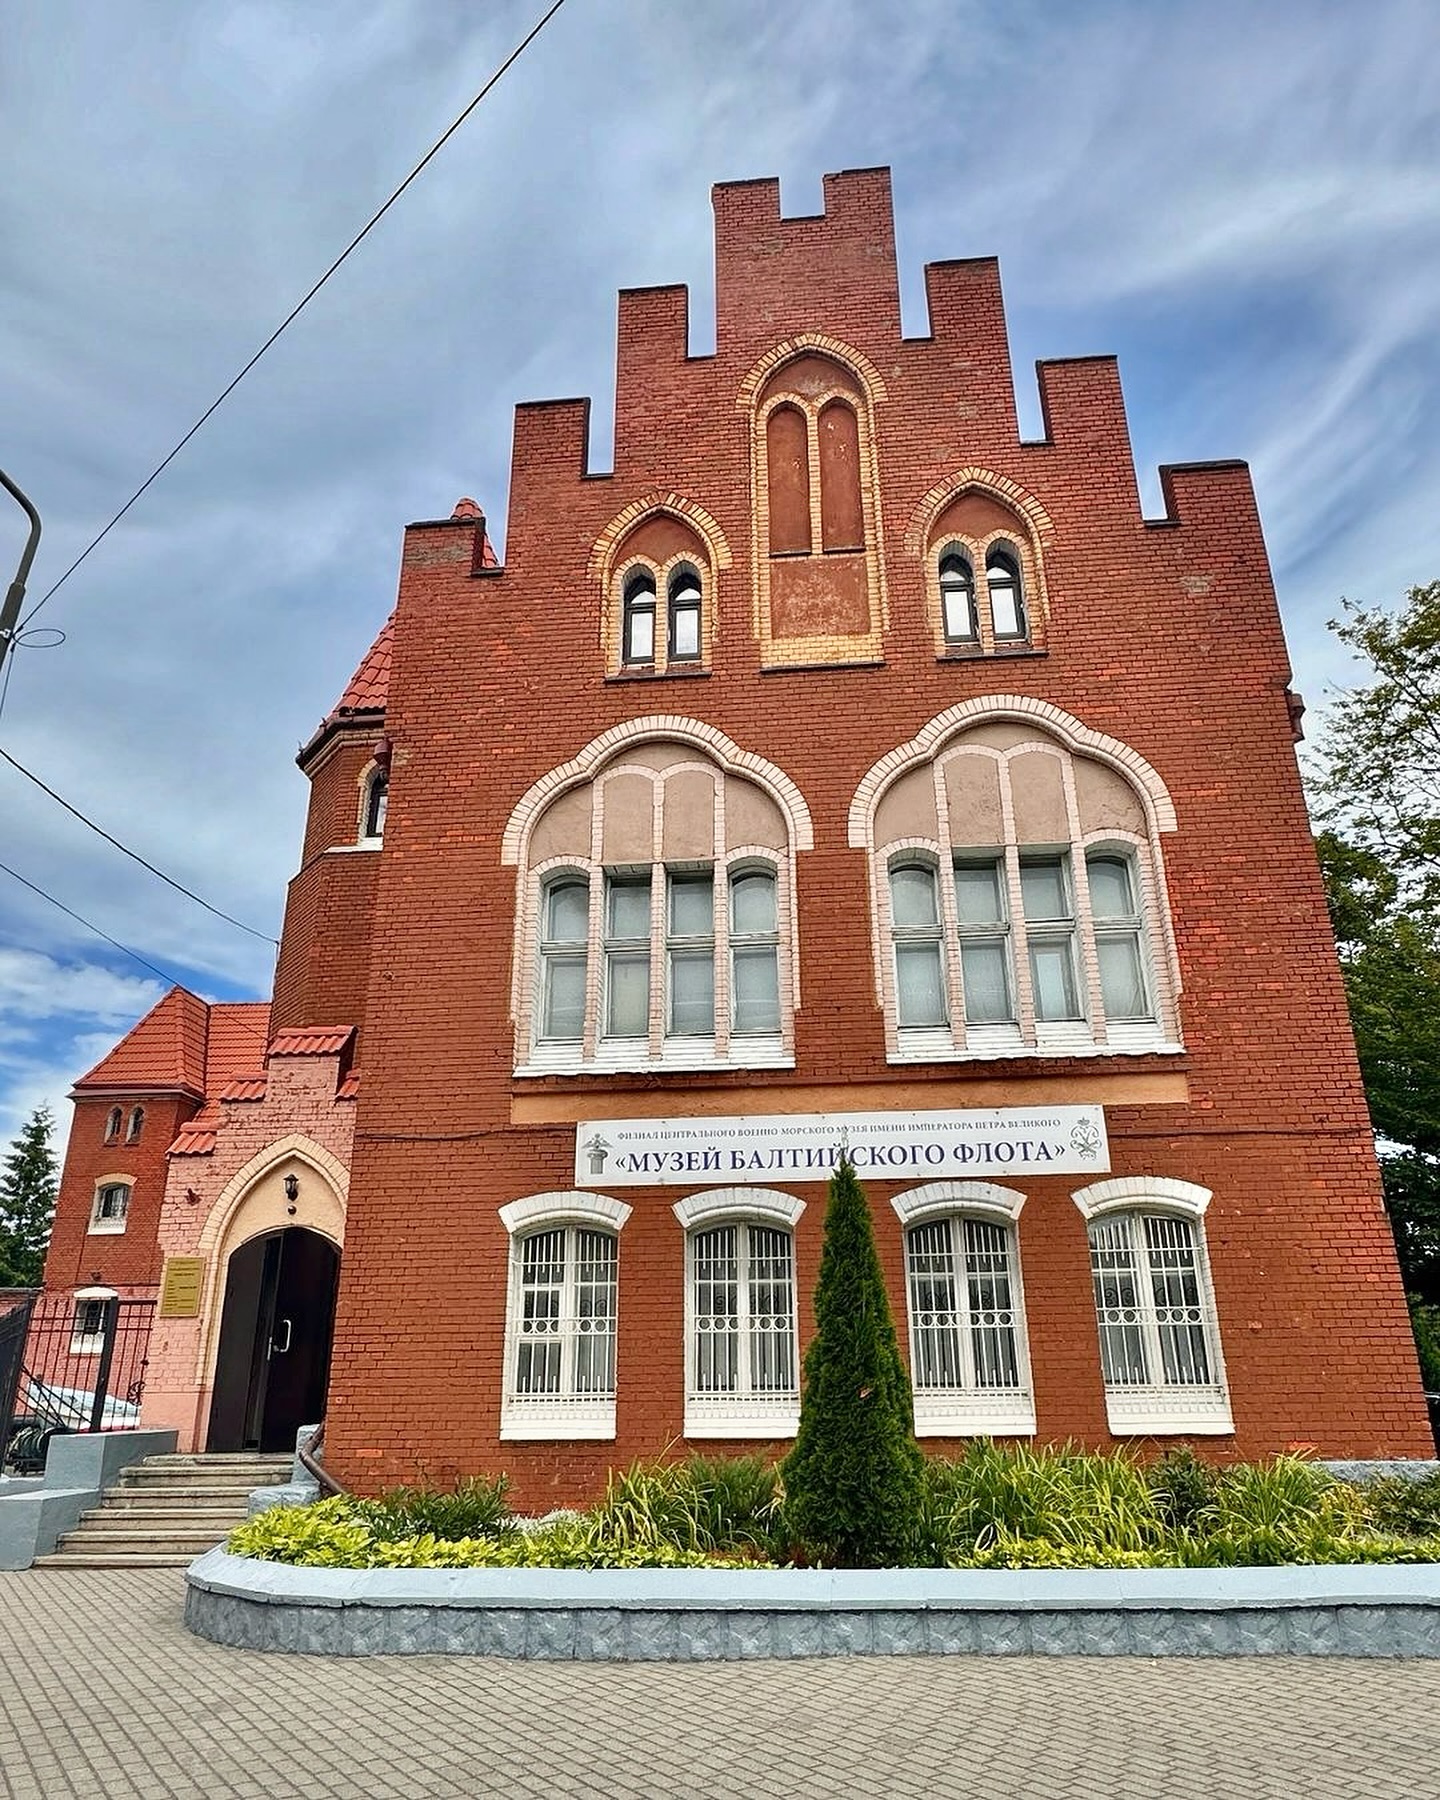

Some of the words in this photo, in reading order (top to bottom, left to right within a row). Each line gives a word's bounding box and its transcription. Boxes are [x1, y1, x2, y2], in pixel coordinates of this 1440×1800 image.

[617, 1131, 658, 1140] ФИЛИАЛ
[660, 1129, 736, 1140] ЦЕНТРАЛЬНОГО
[781, 1126, 834, 1136] МОРСКОГО
[870, 1124, 906, 1133] ИМЕНИ
[908, 1121, 973, 1131] ИМПЕРАТОРА
[975, 1121, 1006, 1130] ПЕТРА
[1008, 1119, 1061, 1129] ВЕЛИКОГО
[615, 1147, 721, 1173] «МУЗЕЙ
[953, 1141, 1066, 1164] ФЛОТА»
